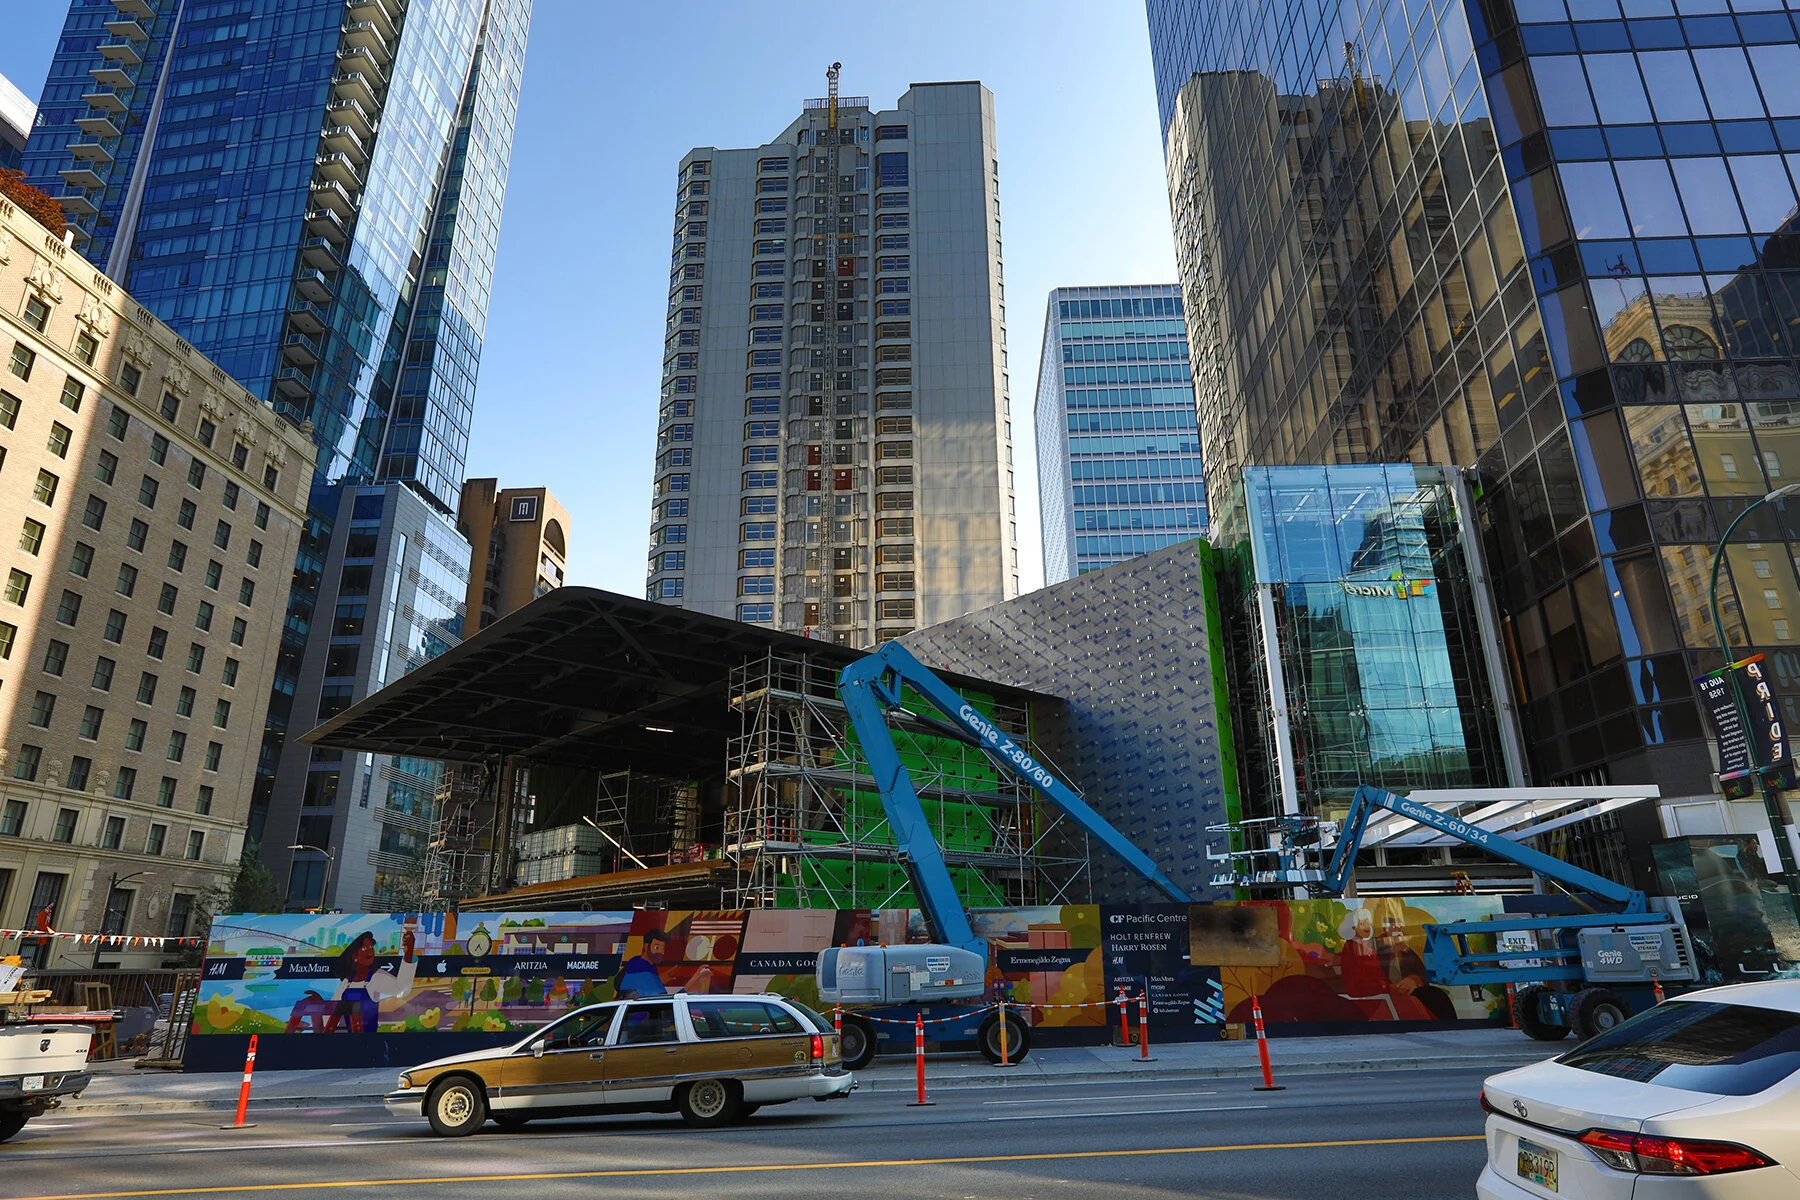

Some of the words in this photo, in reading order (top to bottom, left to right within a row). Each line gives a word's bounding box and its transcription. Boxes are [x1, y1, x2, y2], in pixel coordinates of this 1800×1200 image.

[960, 704, 999, 744] Genie
[999, 739, 1054, 788] Z-80/60
[1400, 801, 1432, 821] Genie
[1433, 814, 1489, 844] Z-60/34
[1109, 914, 1125, 924] CF
[1126, 914, 1156, 923] Pacific
[1156, 913, 1188, 923] Centre
[1110, 933, 1131, 941] HOLT
[1134, 932, 1171, 941] RENFREW
[1507, 937, 1526, 945] EXIT
[1111, 944, 1139, 952] HARRY
[1140, 943, 1167, 951] ROSEN
[1597, 950, 1622, 958] Genie
[566, 960, 599, 970] MACKAGE
[750, 960, 792, 968] CANADA
[1051, 956, 1071, 965] Zegna
[1600, 956, 1623, 965] 4WD
[208, 962, 228, 976] H&M
[288, 963, 330, 973] MaxMara
[514, 961, 548, 970] ARITZIA
